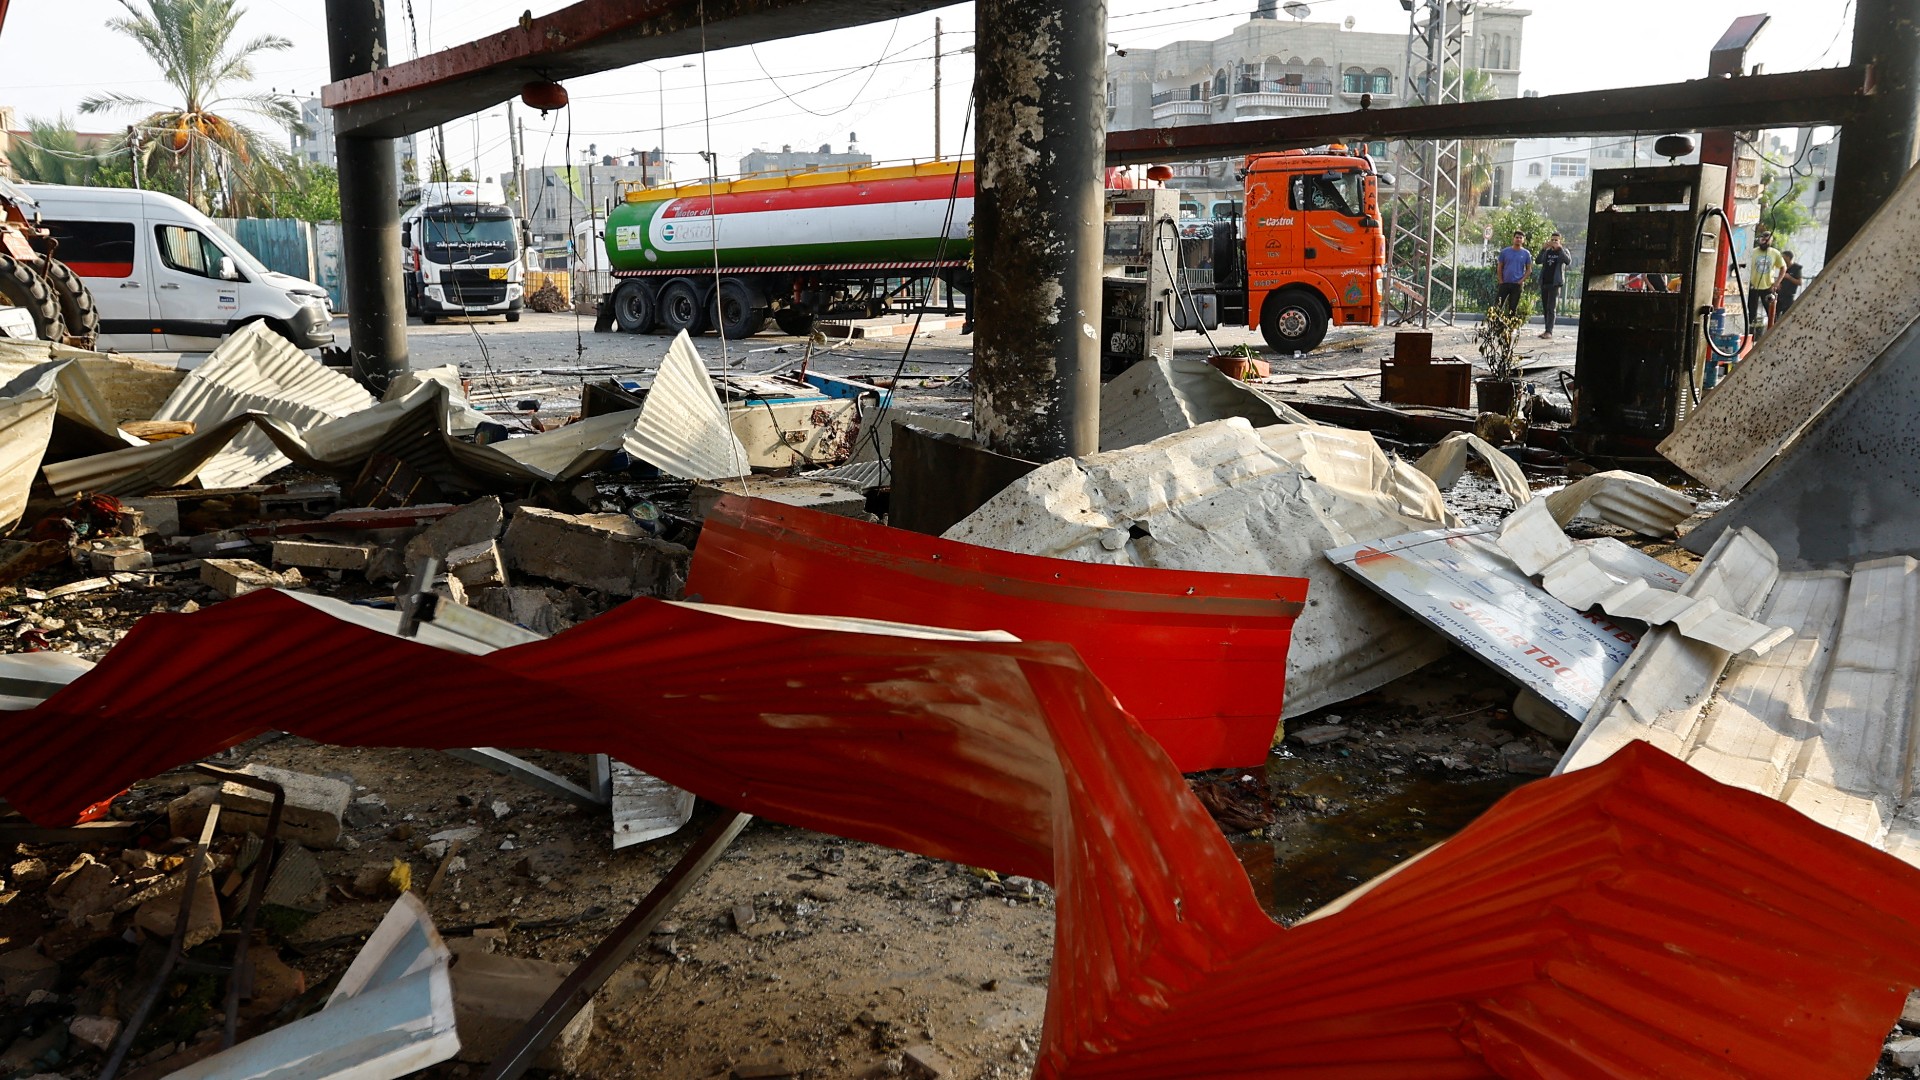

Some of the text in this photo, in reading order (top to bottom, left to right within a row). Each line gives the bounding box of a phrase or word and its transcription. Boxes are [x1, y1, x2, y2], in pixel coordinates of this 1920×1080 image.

[675, 207, 711, 218] Motor oil
[1266, 216, 1294, 226] Castrol
[1541, 610, 1564, 626] SGS
[1427, 604, 1487, 645] Aluminum
[1489, 644, 1554, 689] Composite
[1456, 634, 1480, 650] SGS
